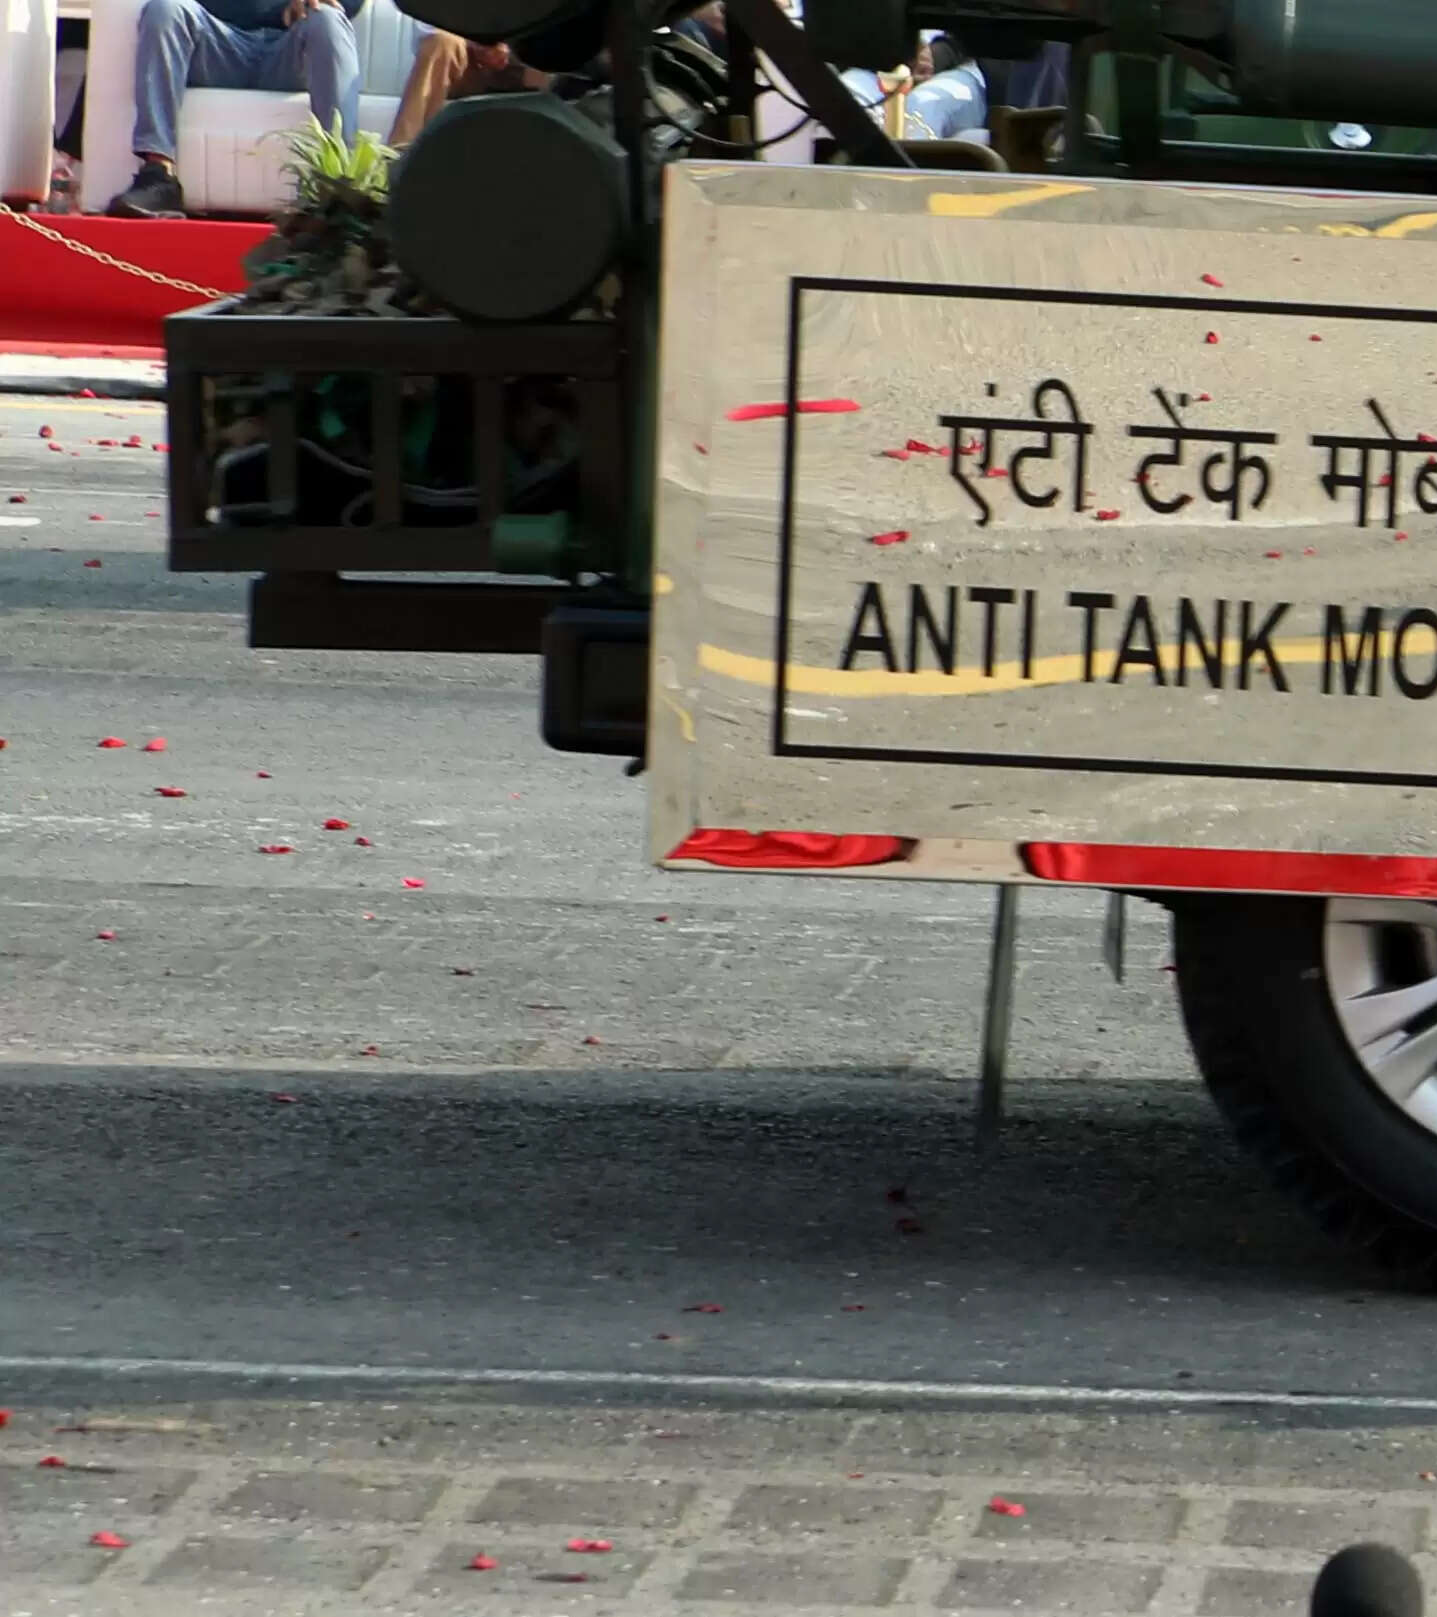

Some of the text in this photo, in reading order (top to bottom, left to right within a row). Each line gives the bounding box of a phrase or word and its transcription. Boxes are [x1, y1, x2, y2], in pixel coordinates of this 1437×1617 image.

[938, 379, 1094, 527] एंटी
[841, 582, 1036, 679] ANTI
[1068, 592, 1292, 693] TANK
